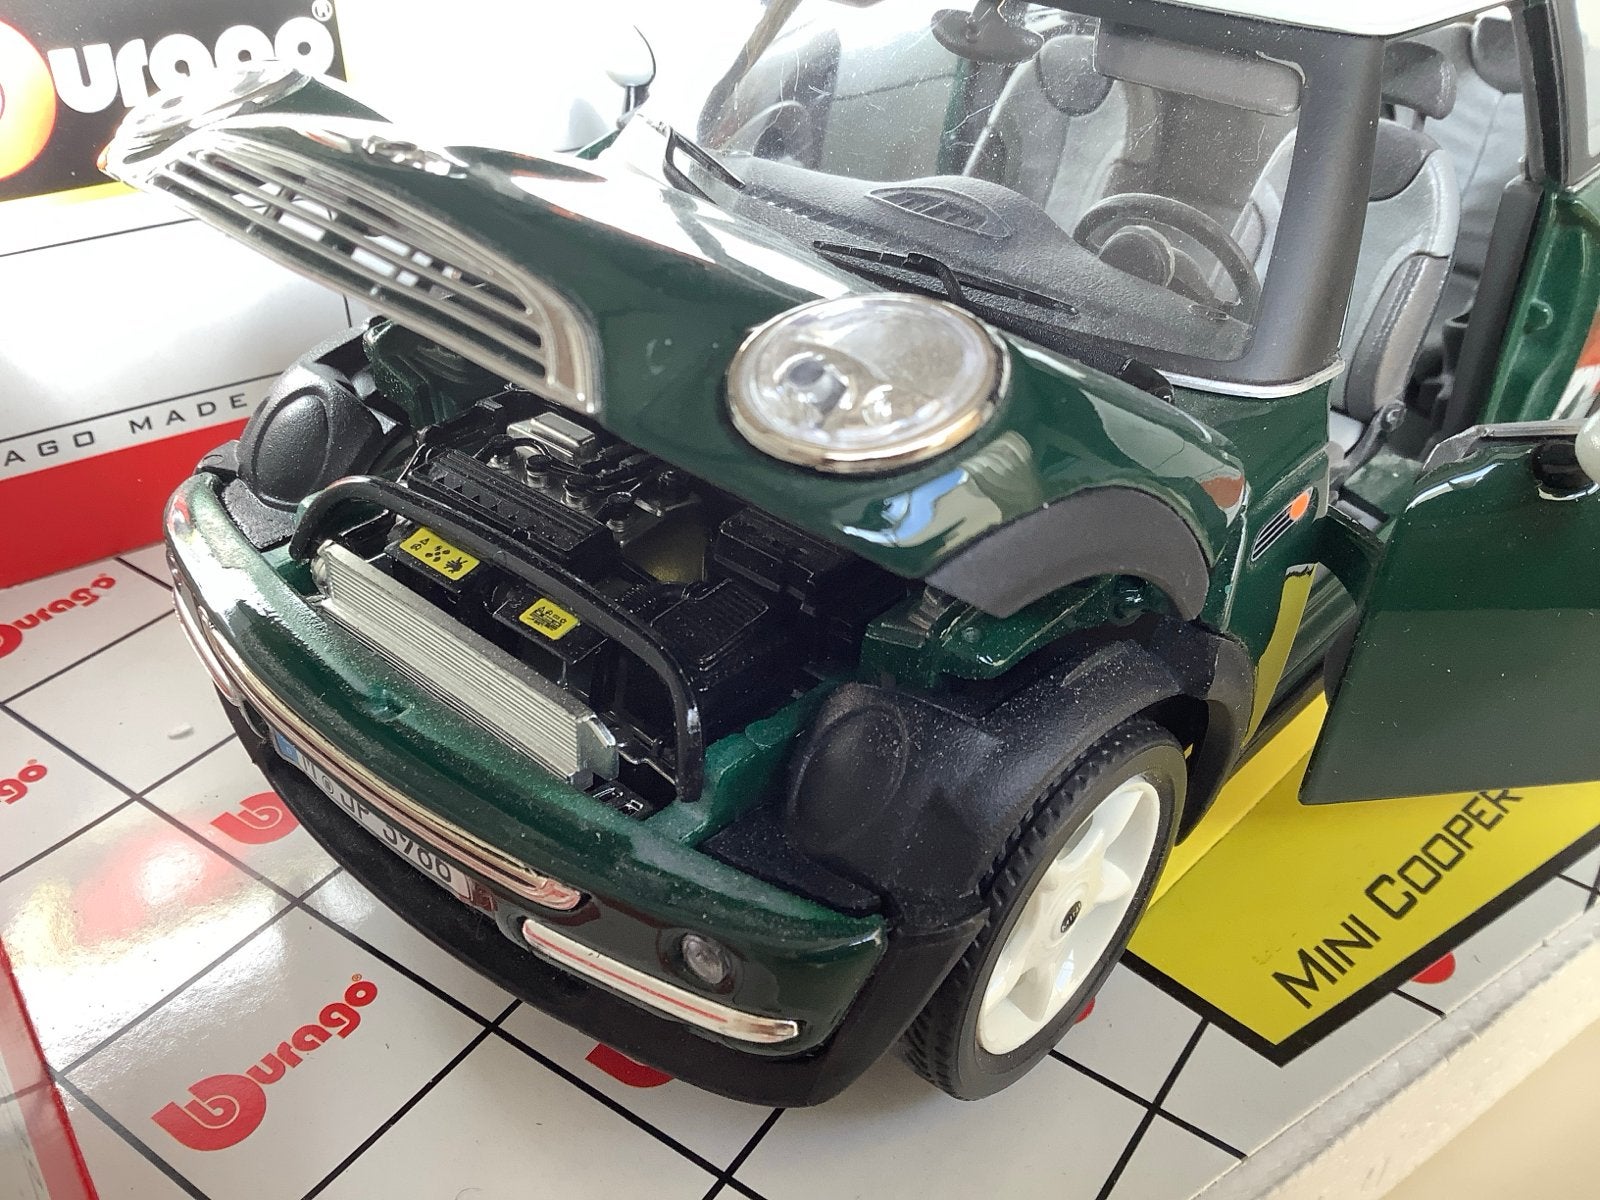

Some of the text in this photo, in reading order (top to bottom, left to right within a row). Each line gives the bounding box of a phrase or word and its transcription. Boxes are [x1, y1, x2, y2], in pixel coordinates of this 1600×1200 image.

[129, 393, 248, 434] MADE
[0, 577, 116, 659] urago
[1272, 914, 1382, 1010] MINI
